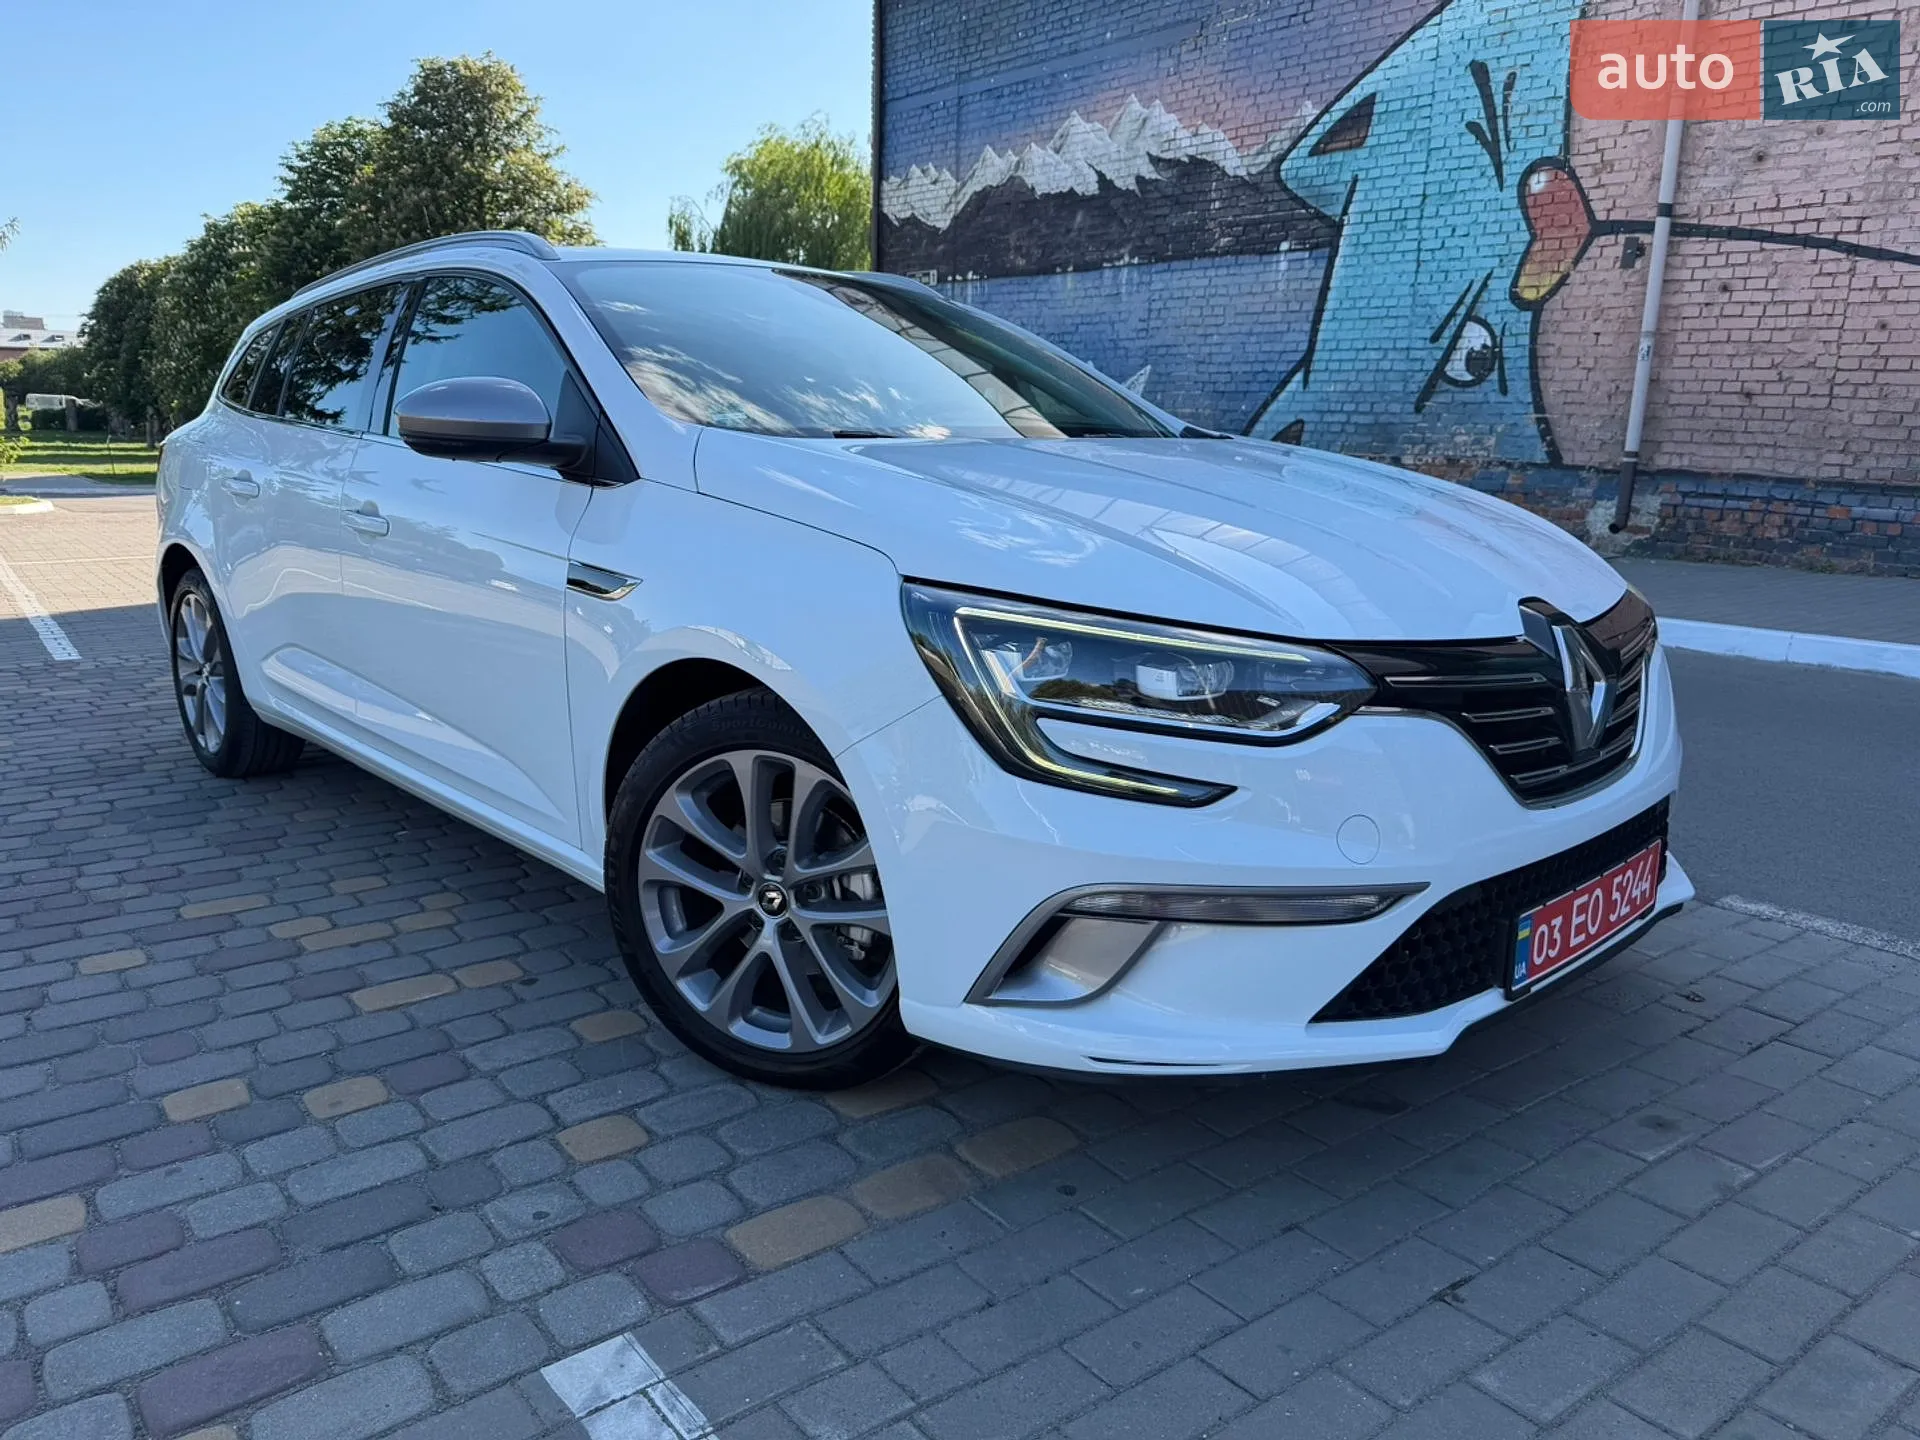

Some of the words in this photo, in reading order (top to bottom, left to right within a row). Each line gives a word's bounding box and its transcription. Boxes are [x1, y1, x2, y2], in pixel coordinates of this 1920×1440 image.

[1533, 916, 1562, 965] 03
[1569, 887, 1603, 947] EO
[1609, 854, 1653, 922] 5244
[1514, 961, 1527, 979] UA
